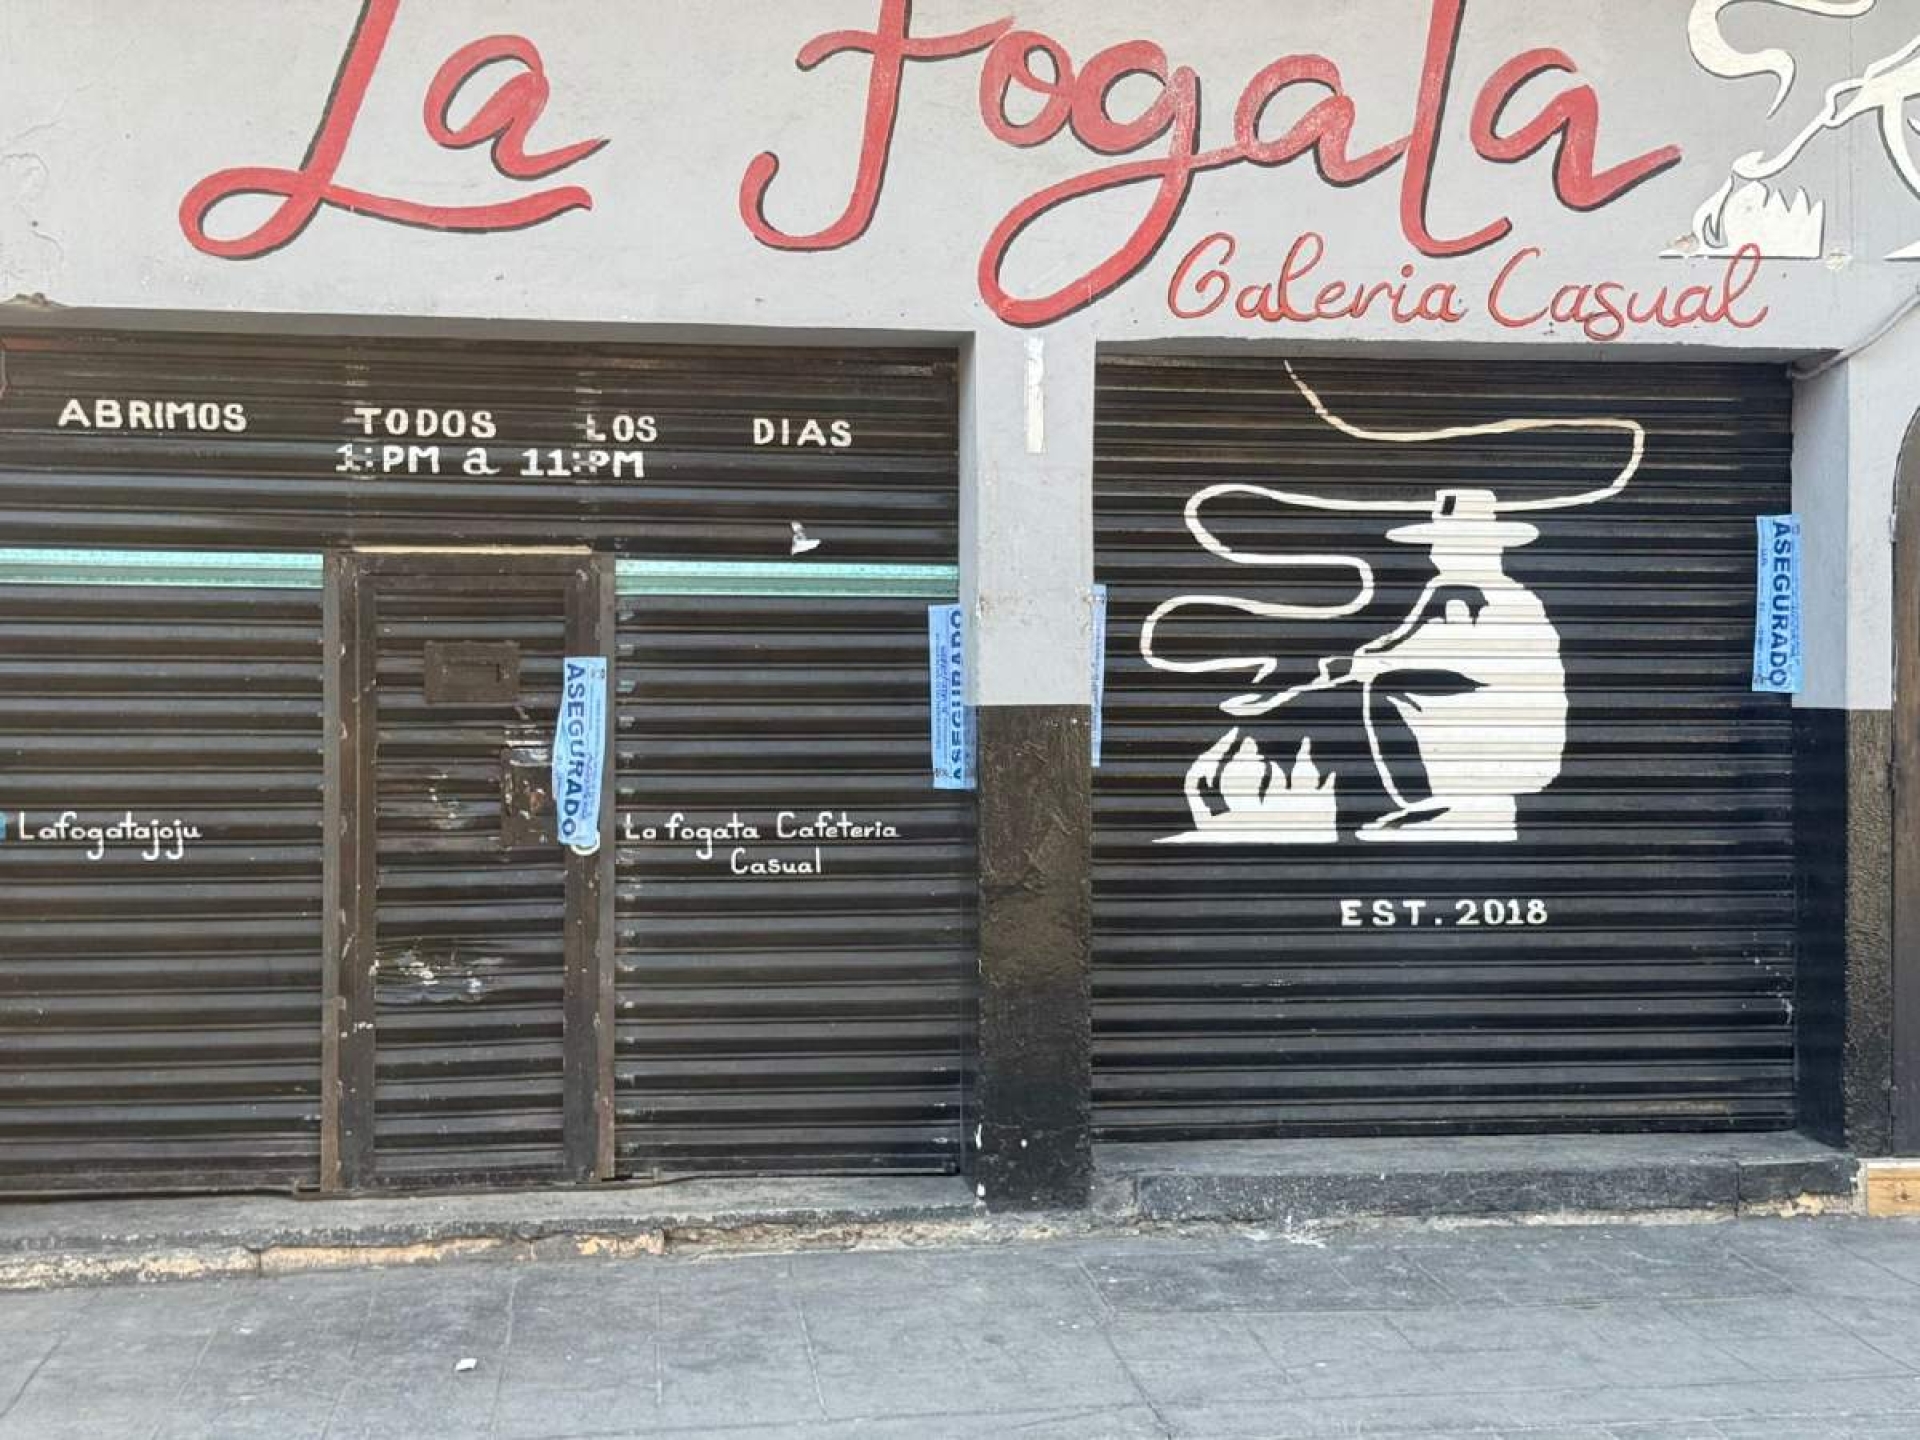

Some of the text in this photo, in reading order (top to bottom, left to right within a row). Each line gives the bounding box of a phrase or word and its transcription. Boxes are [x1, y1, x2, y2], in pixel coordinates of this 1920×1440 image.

[178, 0, 609, 260] La
[1167, 231, 1769, 341] Galeria Casual
[57, 398, 853, 448] ABRIMOS TODOS LOS DIAS
[335, 443, 646, 478] 1:PM a 11:PM
[1769, 520, 1792, 686] ASEGURADO
[561, 663, 586, 836] ASEGURADO
[18, 810, 203, 861] Lafogatajoju
[664, 812, 761, 860] fogata
[777, 811, 901, 839] Cafeteria
[731, 847, 823, 875] Casual
